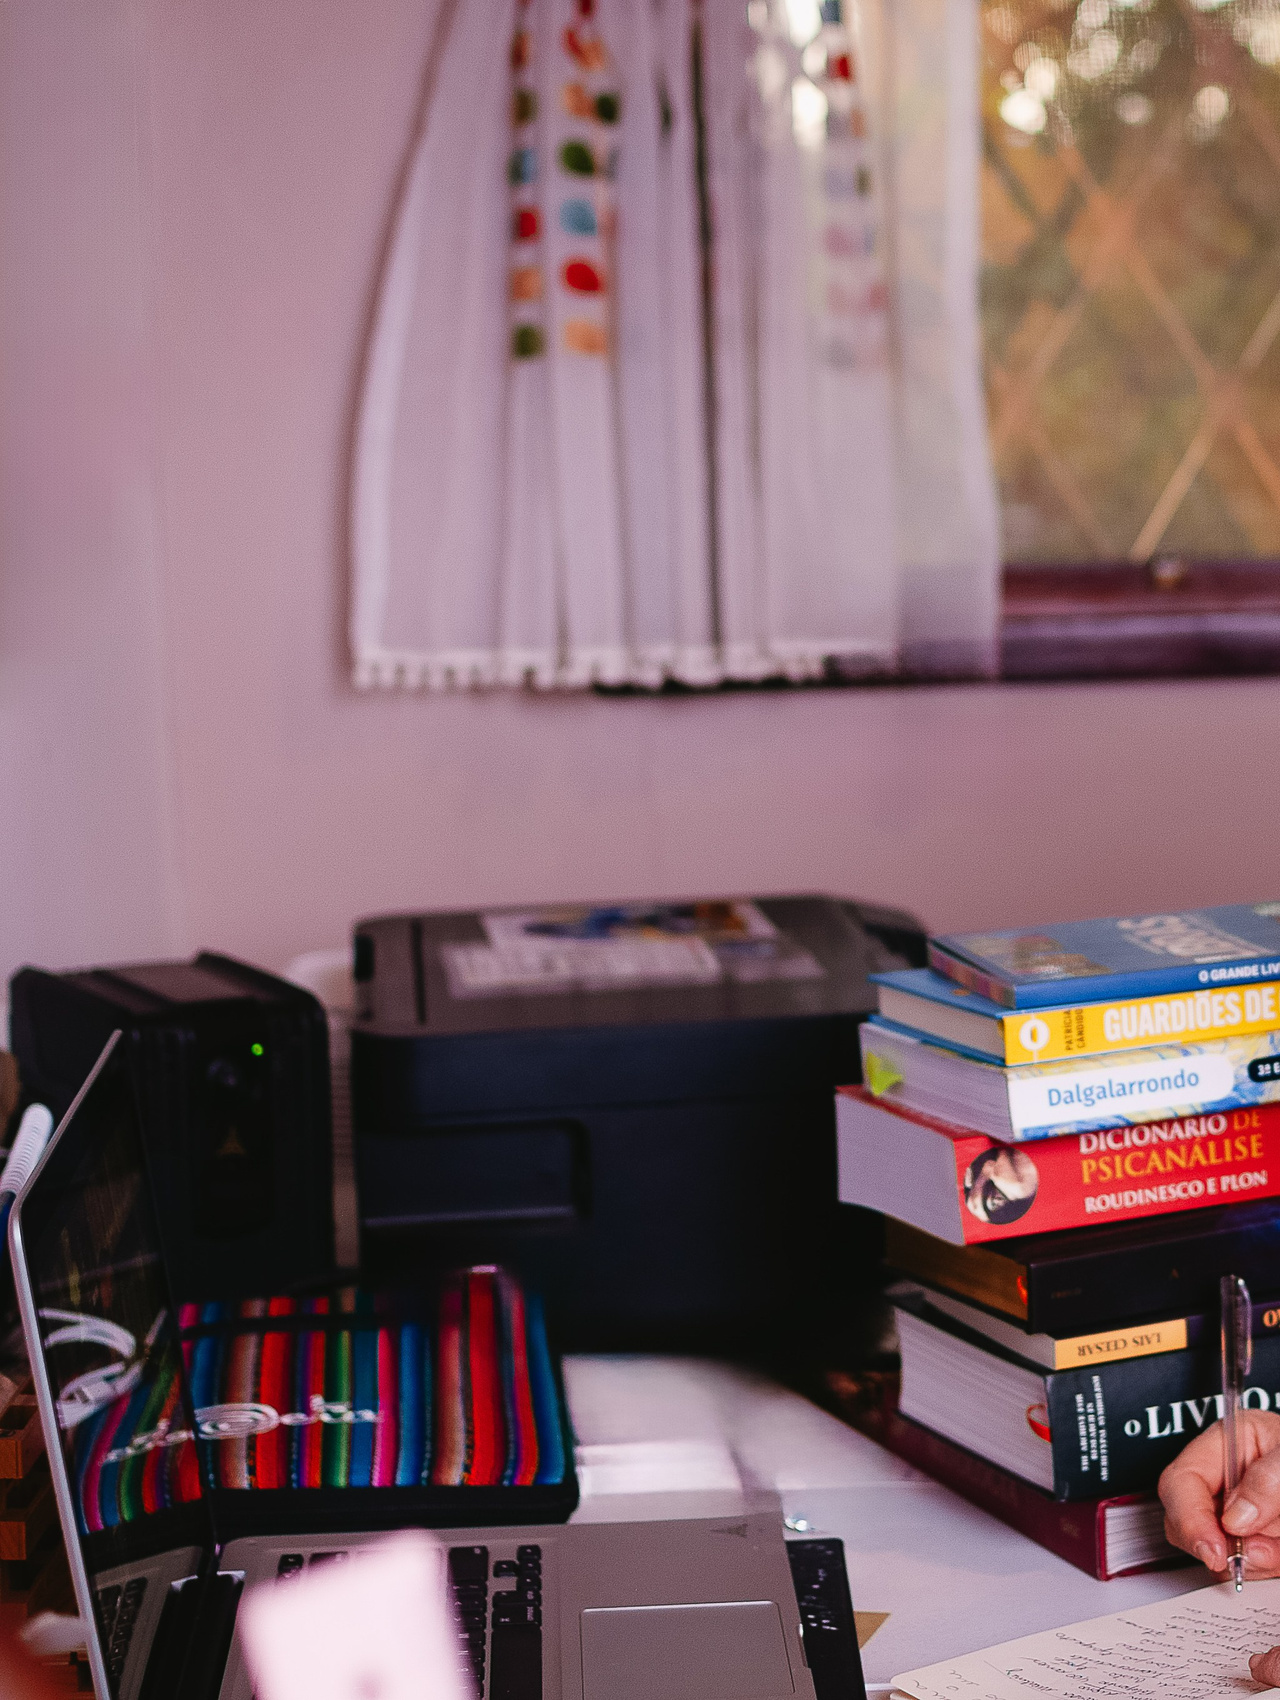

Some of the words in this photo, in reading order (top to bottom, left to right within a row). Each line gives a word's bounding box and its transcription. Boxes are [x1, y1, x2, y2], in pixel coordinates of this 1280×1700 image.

[1199, 970, 1210, 983] O
[1211, 963, 1259, 982] GRANDE
[1103, 990, 1242, 1042] GUARDIÕES
[1244, 987, 1276, 1022] DE
[1047, 1068, 1200, 1107] Dalgalarrondo
[1232, 1111, 1261, 1131] DE
[1081, 1134, 1264, 1184] PSICANÁLISE
[1084, 1180, 1204, 1214] ROUDINESCO
[1206, 1178, 1216, 1195] E
[1220, 1170, 1268, 1192] PLON
